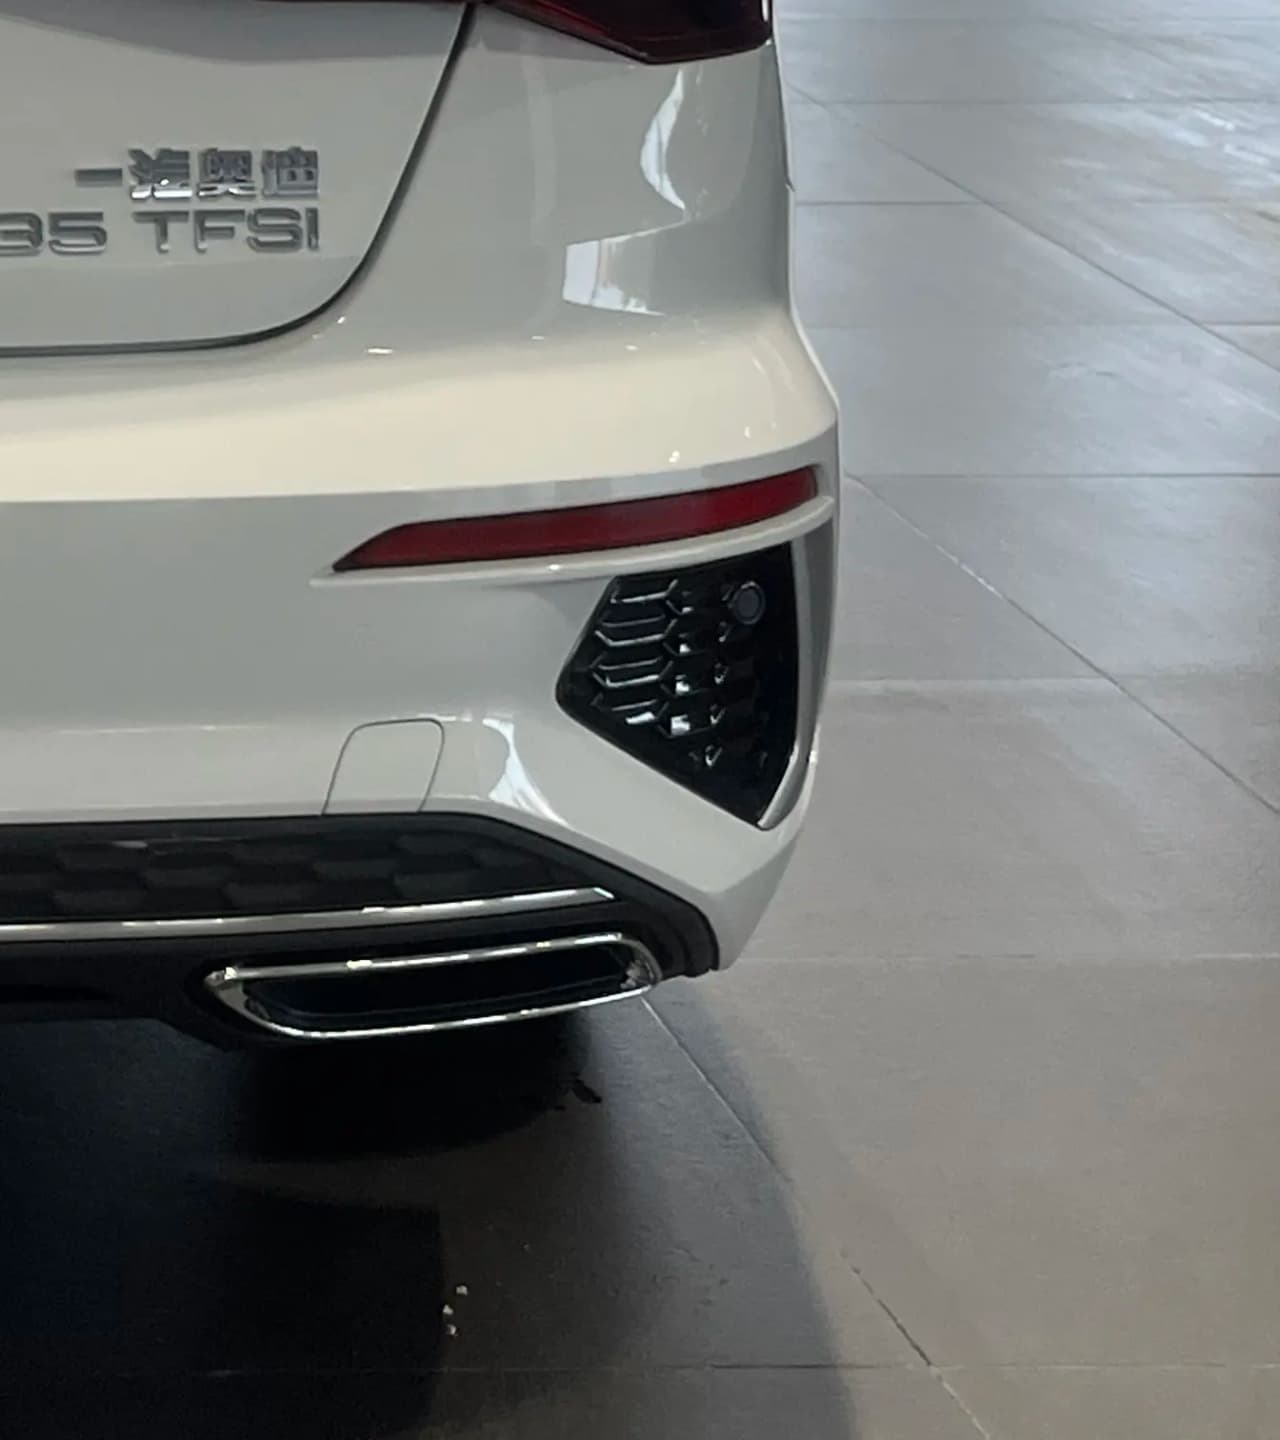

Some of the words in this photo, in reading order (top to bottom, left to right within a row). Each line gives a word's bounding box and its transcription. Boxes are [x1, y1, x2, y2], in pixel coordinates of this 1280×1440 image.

[75, 147, 320, 200] 一汽奥迪
[131, 207, 320, 254] TFSI
